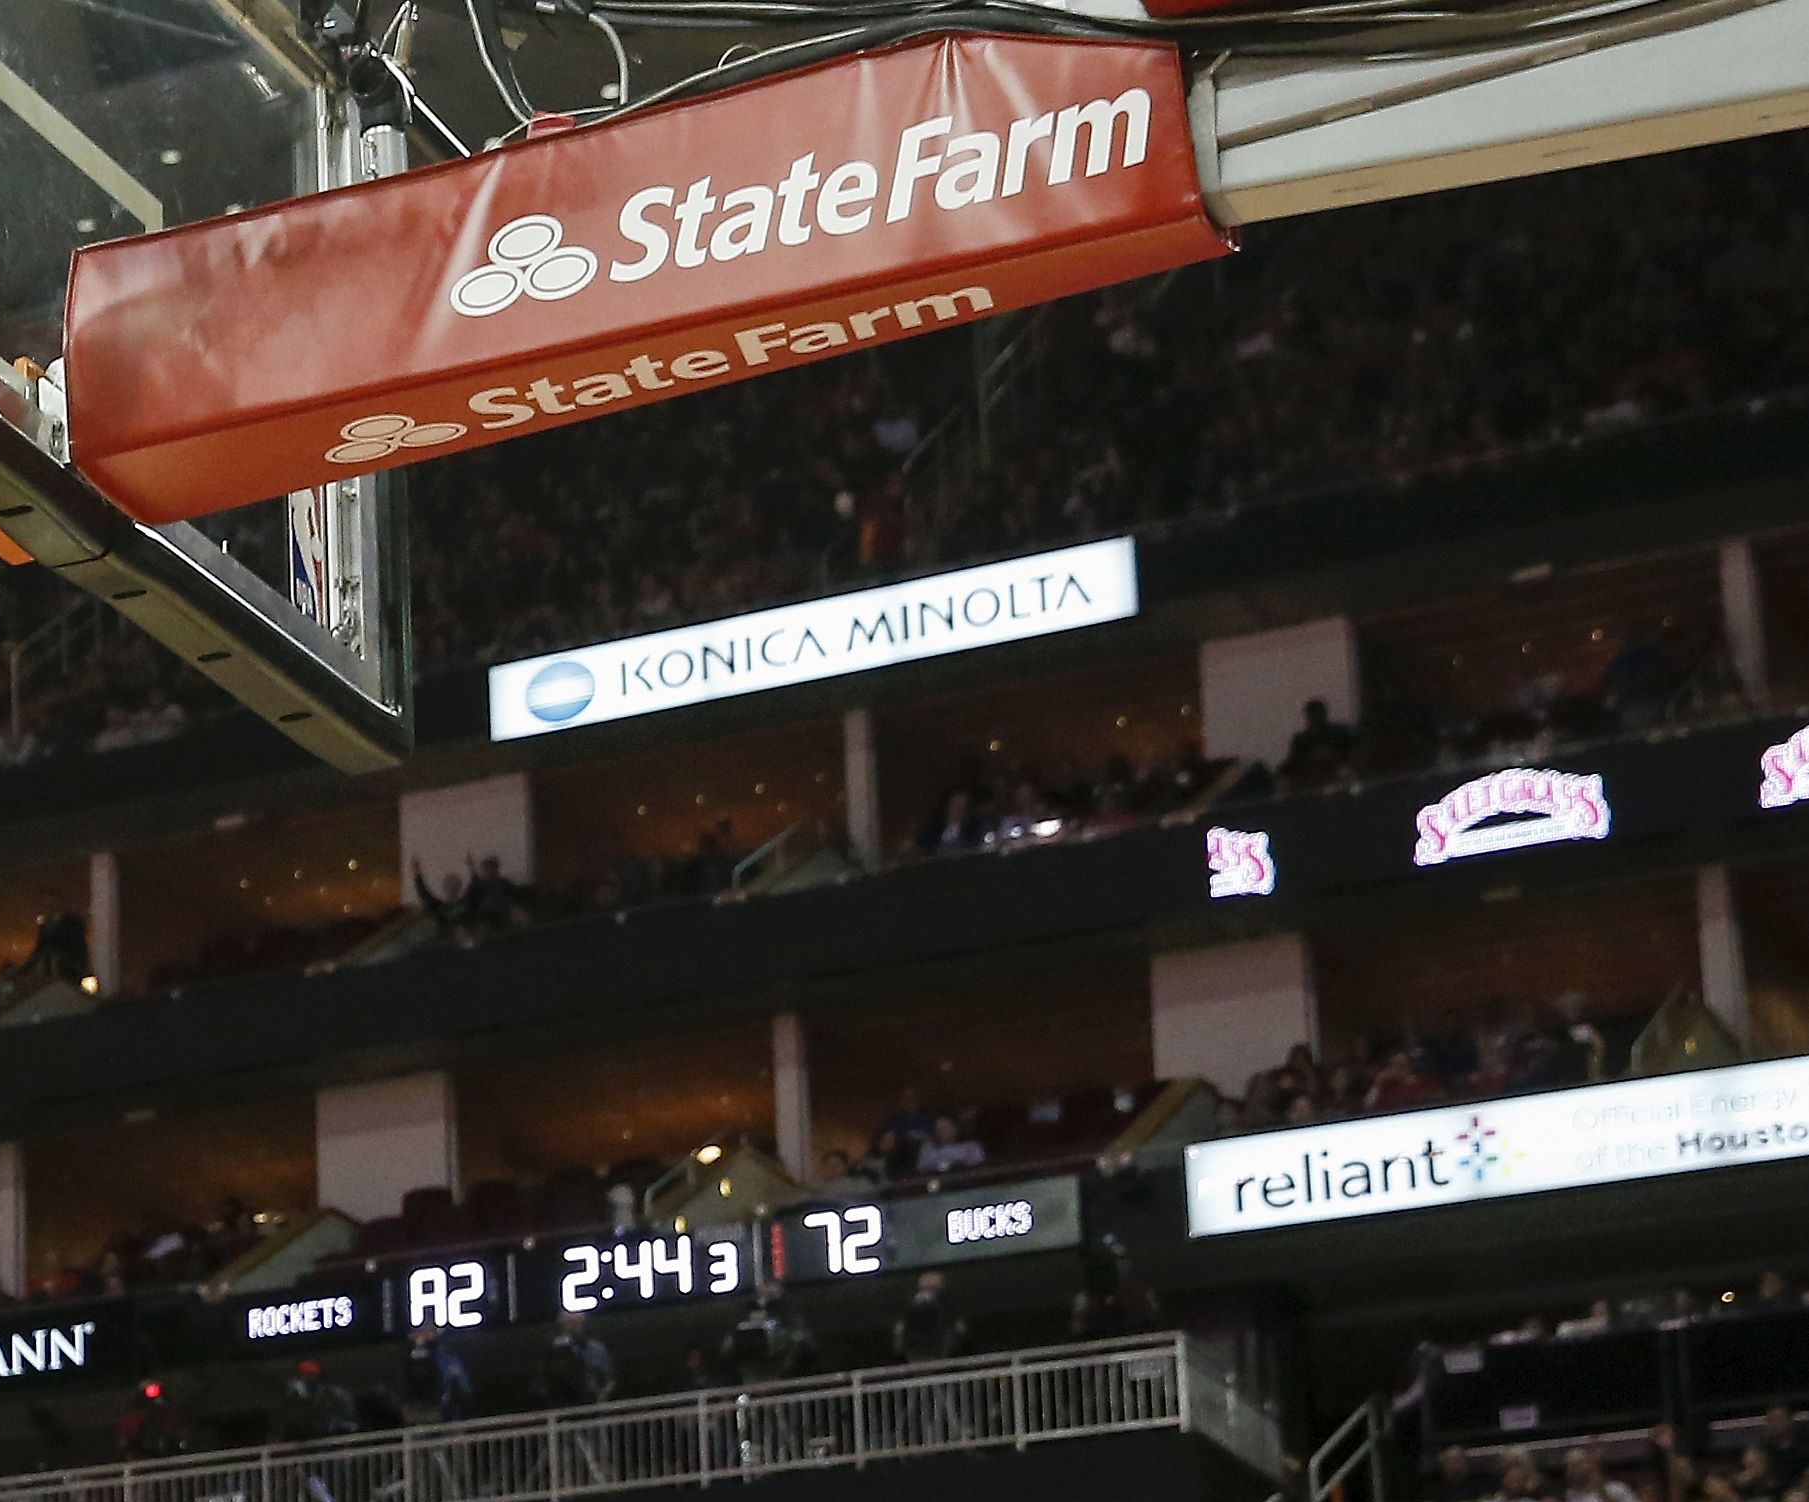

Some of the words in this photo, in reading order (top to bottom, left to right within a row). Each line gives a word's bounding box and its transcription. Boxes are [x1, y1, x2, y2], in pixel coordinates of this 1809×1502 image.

[468, 353, 730, 430] State
[734, 285, 994, 367] Farm
[619, 627, 827, 697] KONICA
[846, 573, 1092, 652] MINOLTA
[1234, 1140, 1450, 1213] reliant
[1675, 1121, 1809, 1158] Housto
[248, 1296, 353, 1339] ROCKETS
[561, 1235, 693, 1313] 2:44
[708, 1241, 740, 1294] 3
[803, 1205, 883, 1275] 72
[947, 1200, 1033, 1244] BUCKS
